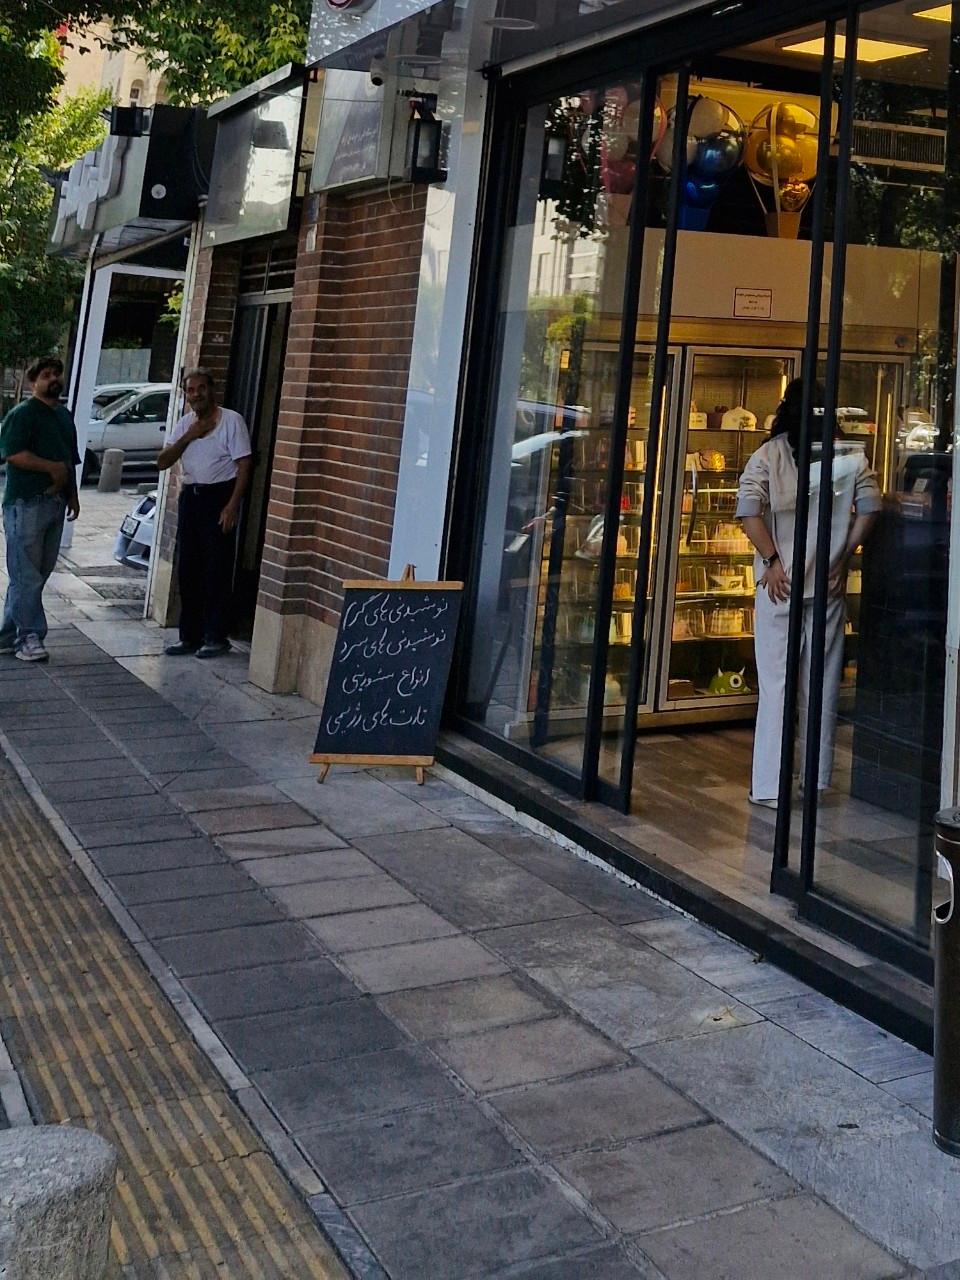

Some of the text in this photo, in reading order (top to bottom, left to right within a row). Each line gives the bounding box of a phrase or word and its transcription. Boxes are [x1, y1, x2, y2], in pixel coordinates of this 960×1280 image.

[342, 591, 384, 631] گرم
[389, 595, 448, 624] نوشیدنی
[339, 636, 369, 663] سرد
[386, 627, 447, 656] نوشیدنی
[396, 666, 431, 697] انواع
[326, 701, 362, 735] رژیمی
[389, 705, 428, 726] تارت
